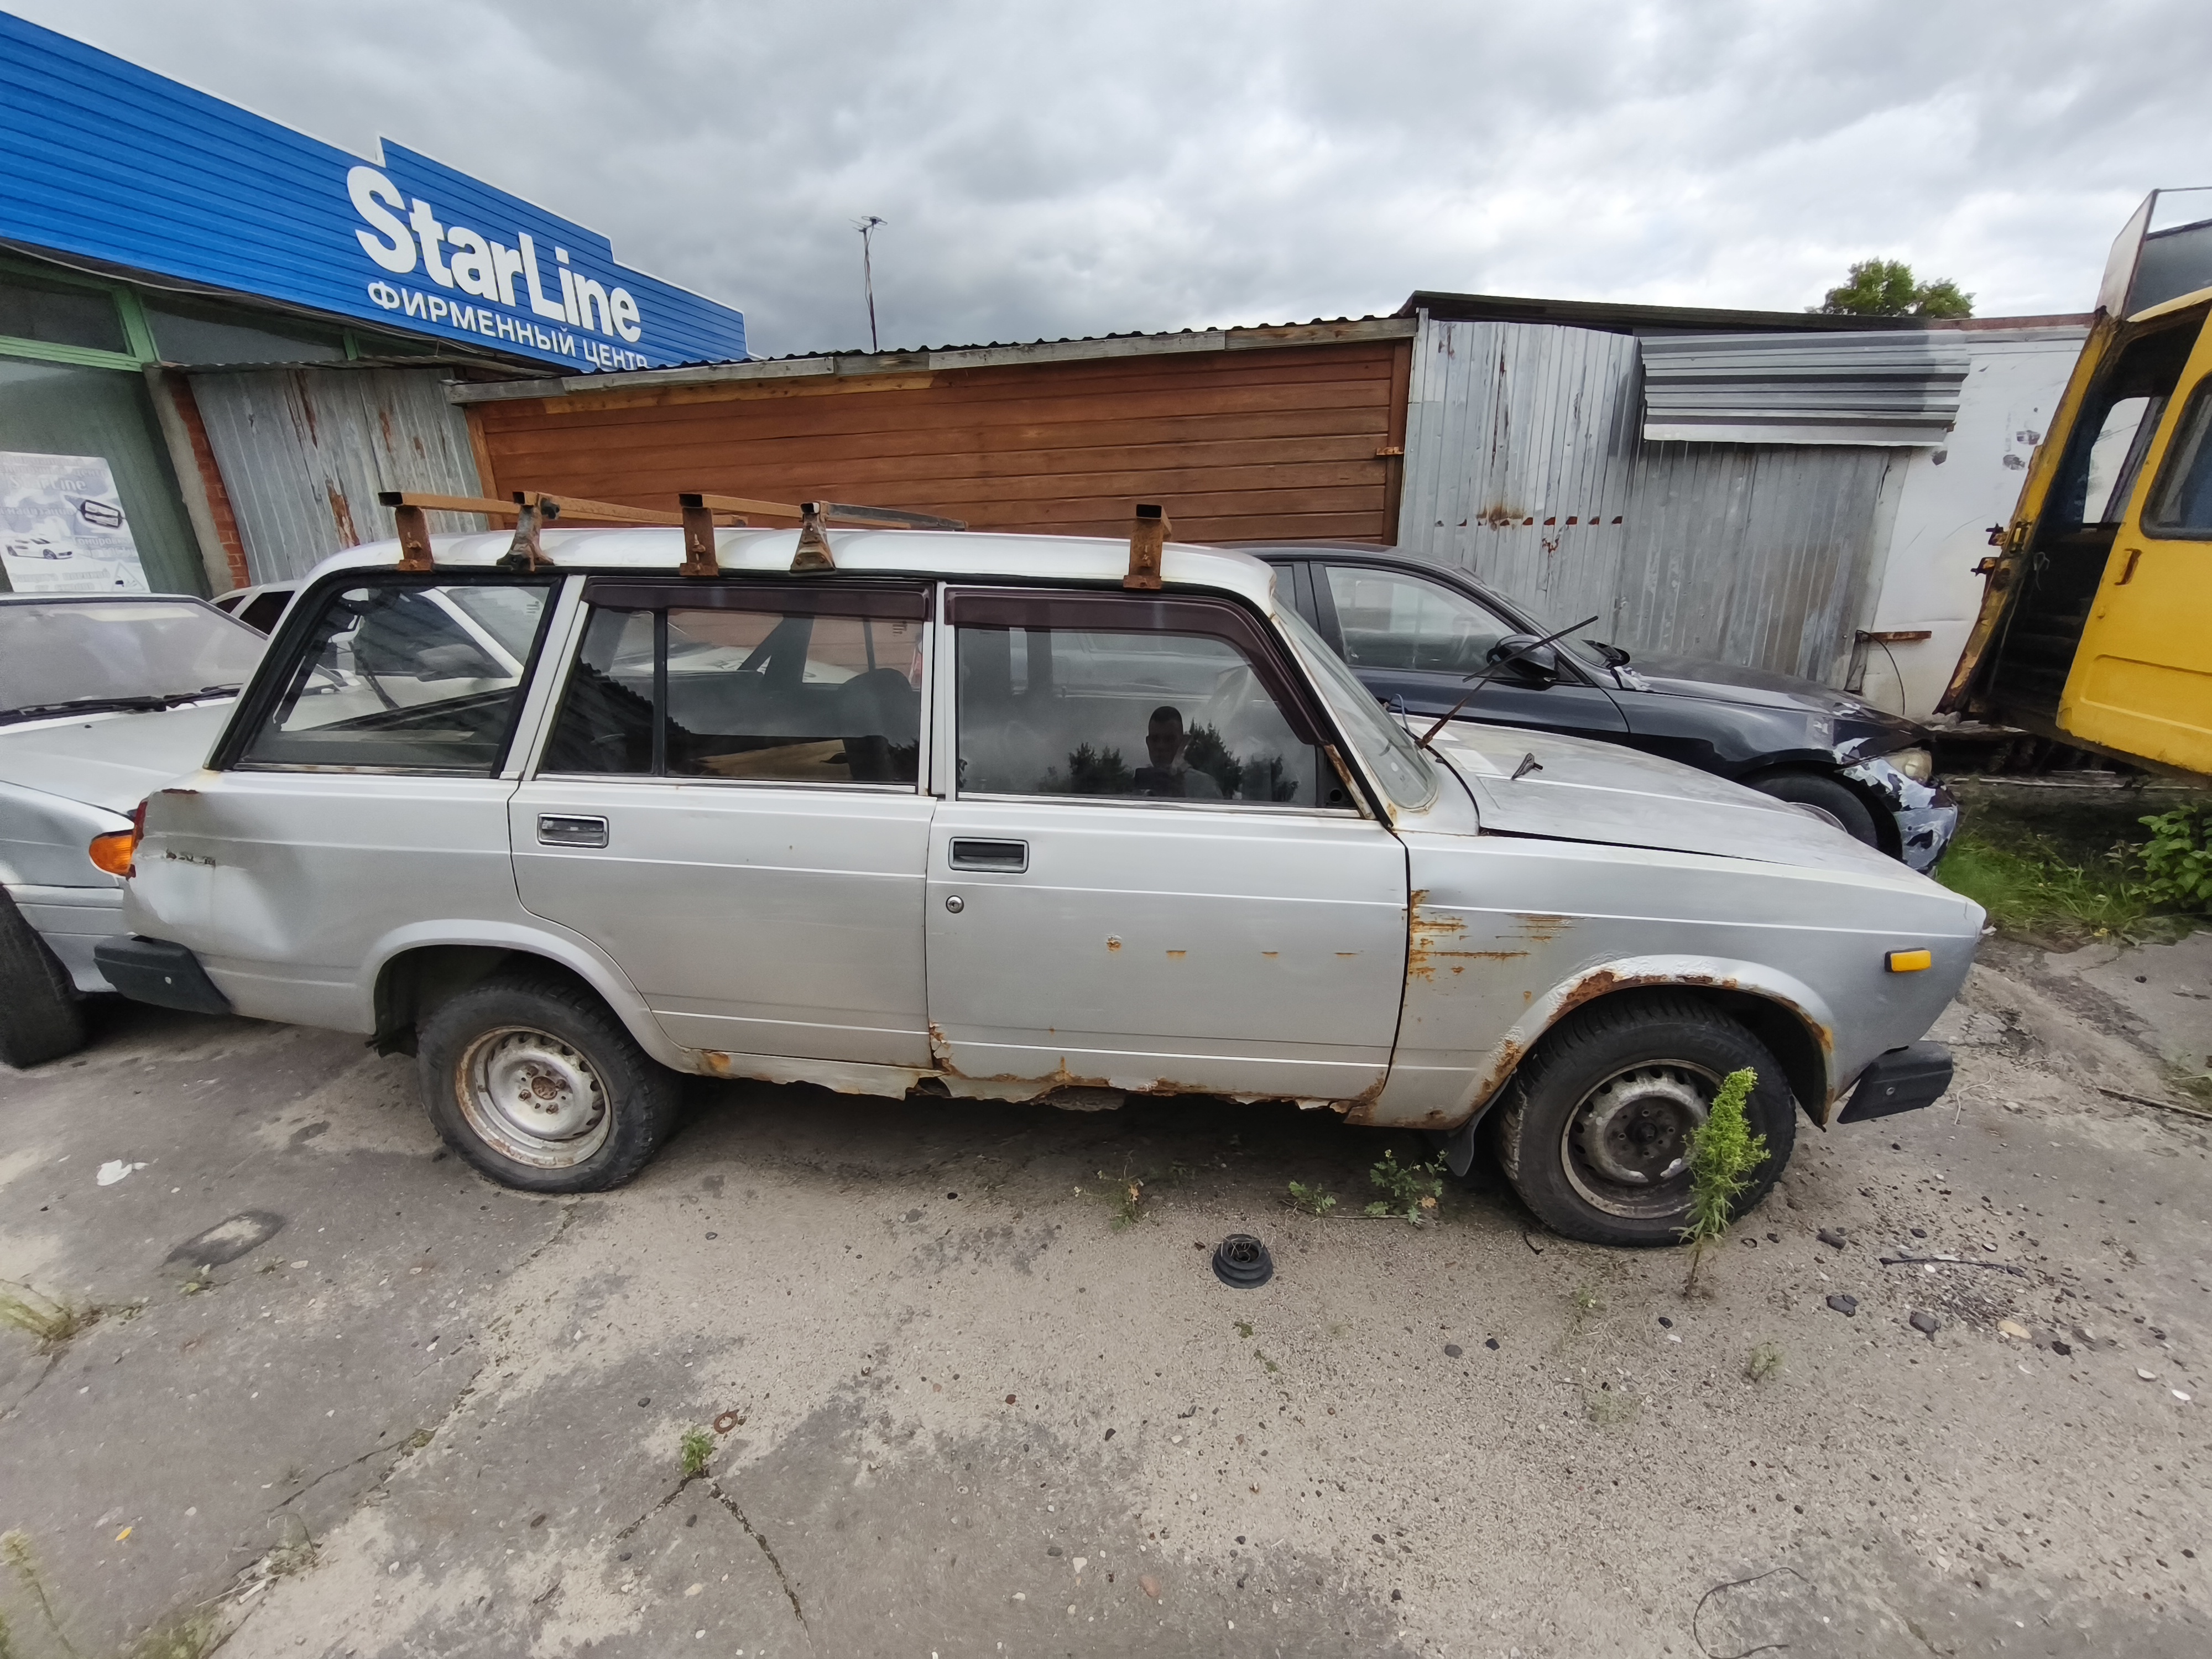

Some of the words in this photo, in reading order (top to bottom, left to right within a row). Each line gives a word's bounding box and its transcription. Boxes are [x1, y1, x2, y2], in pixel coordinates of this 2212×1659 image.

[347, 166, 641, 342] StarLine
[367, 280, 576, 358] ФИРМЕННЫЙ
[582, 338, 648, 370] ЦЕНТР
